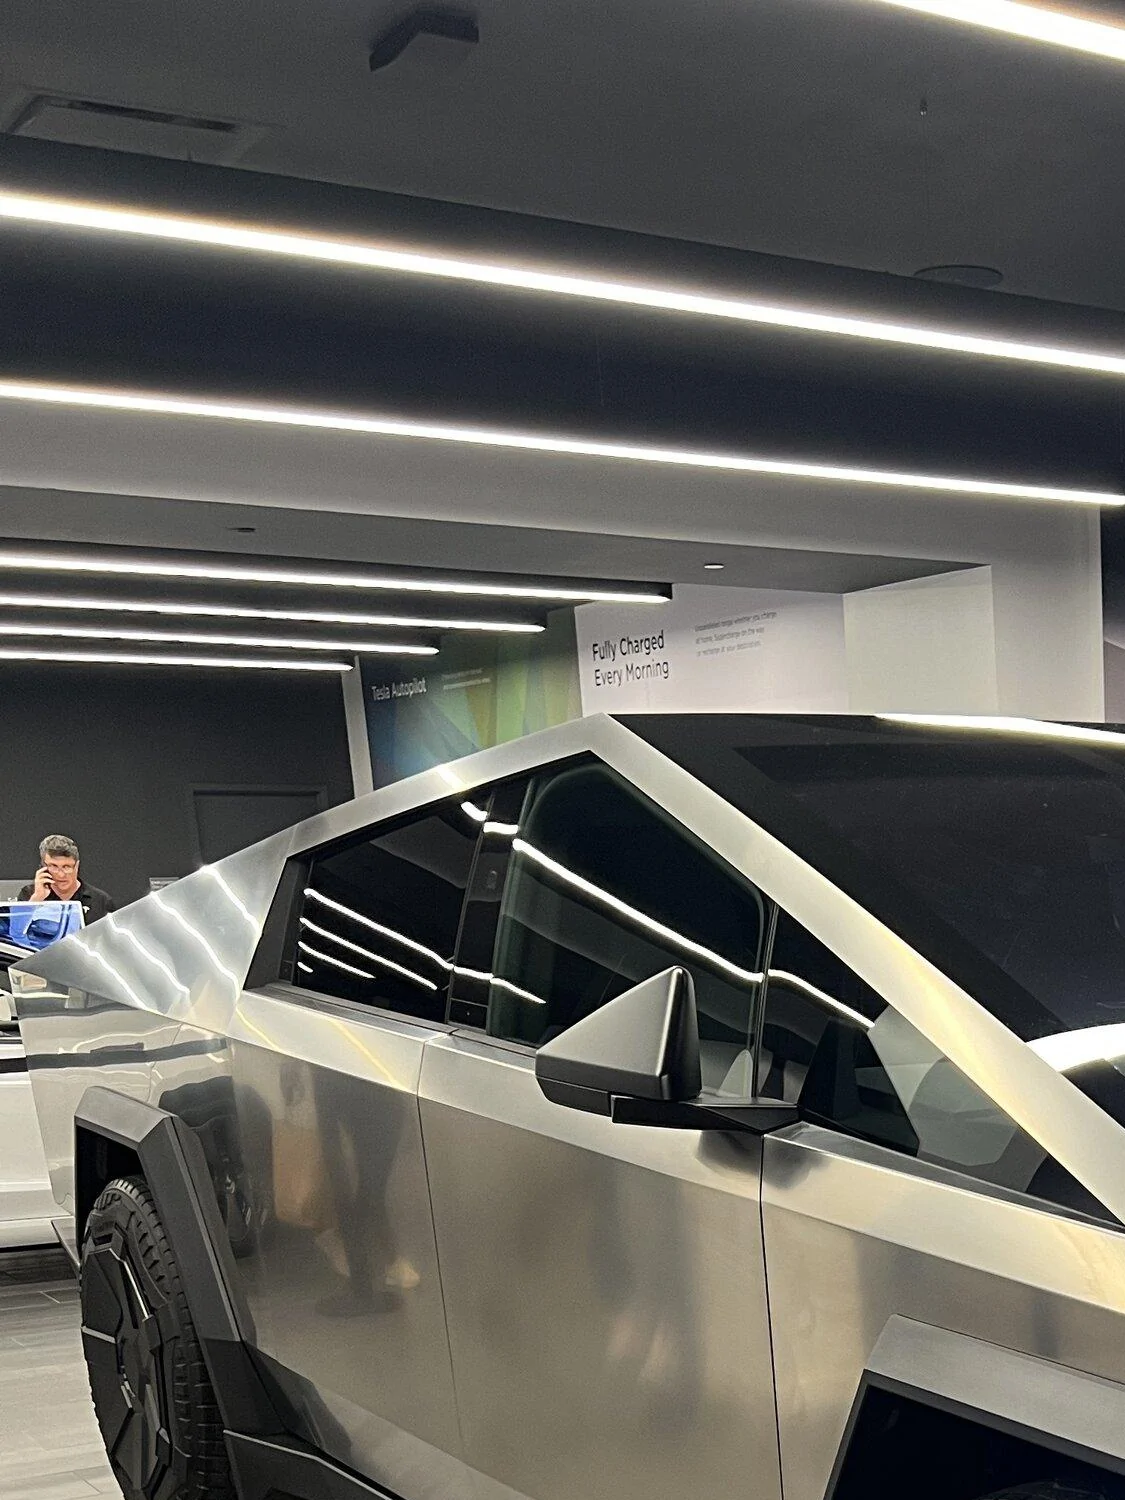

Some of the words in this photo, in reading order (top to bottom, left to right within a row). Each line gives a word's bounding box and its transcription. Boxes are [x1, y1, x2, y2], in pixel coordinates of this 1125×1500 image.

[592, 639, 617, 662] Fully
[619, 629, 665, 656] Charged
[594, 668, 623, 687] Every
[625, 658, 669, 681] Morning
[371, 684, 391, 701] Tesla
[391, 677, 427, 698] Autopilot
